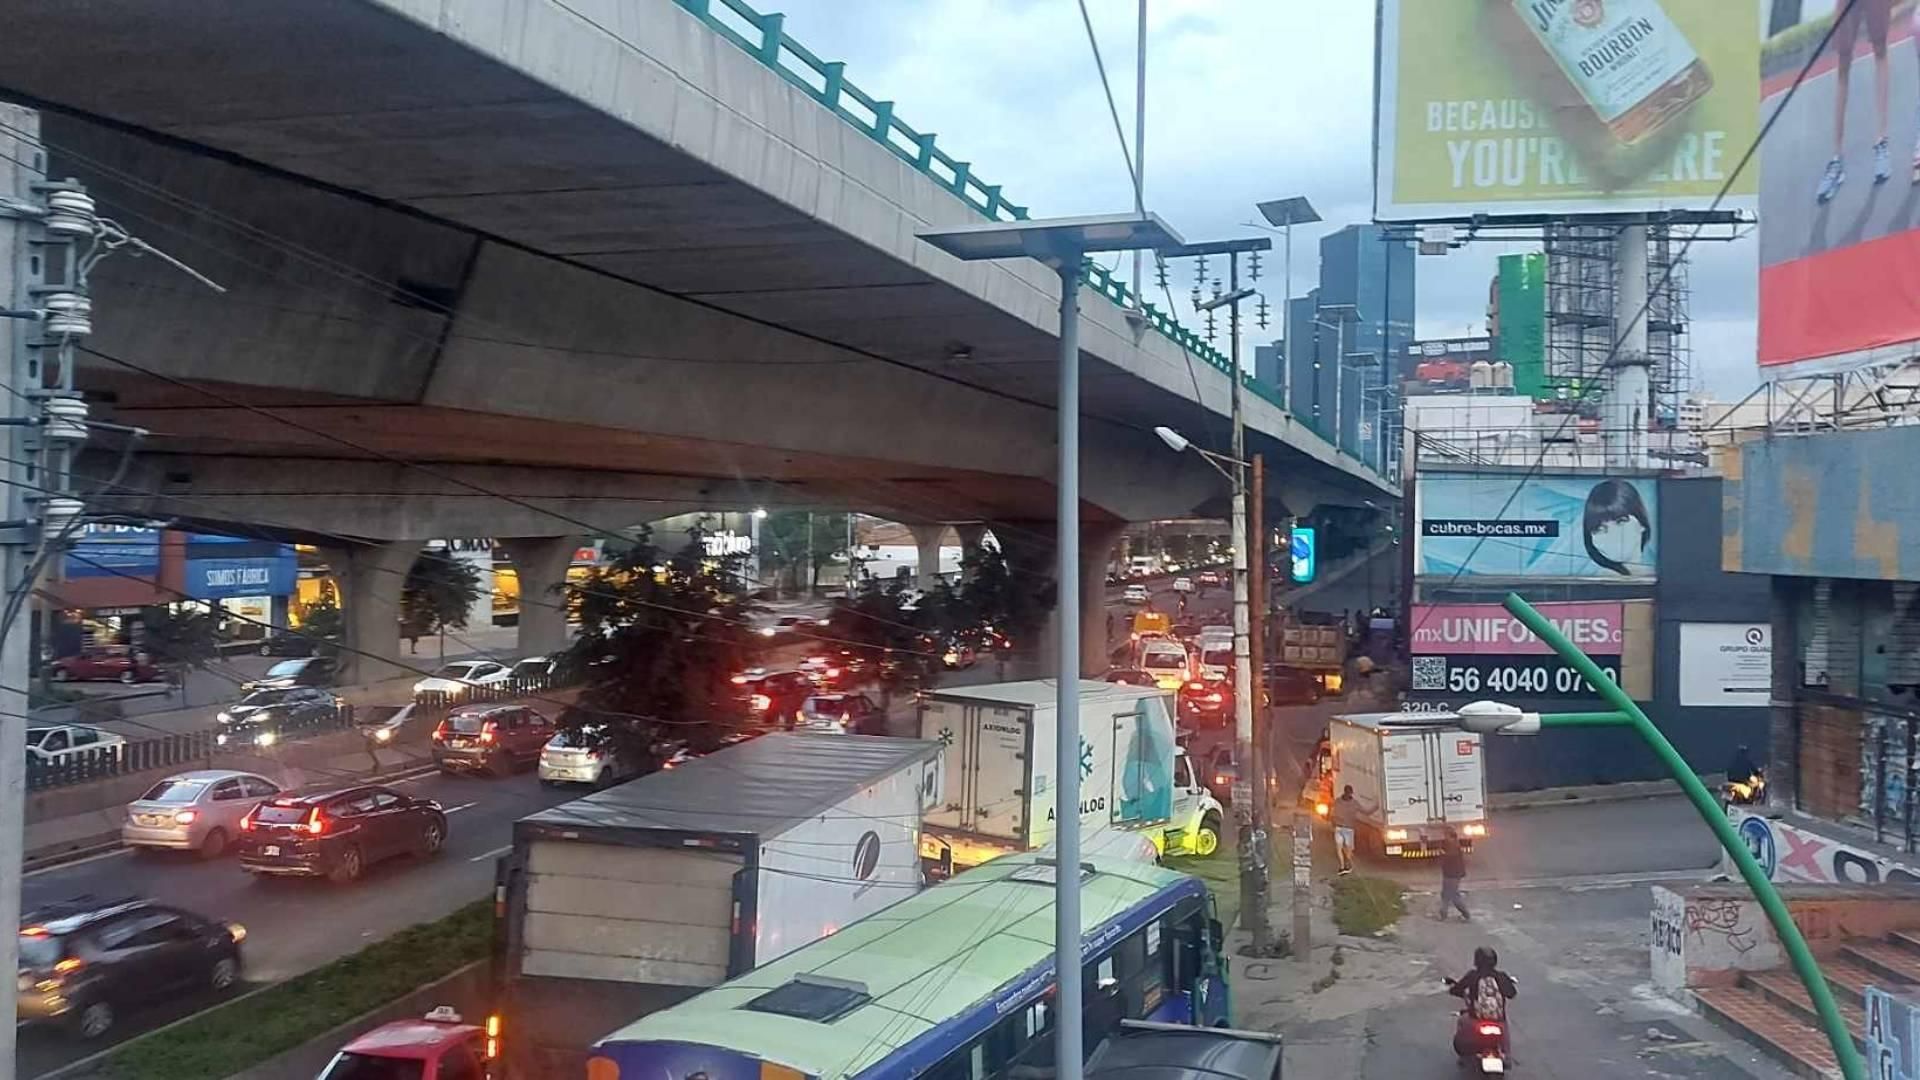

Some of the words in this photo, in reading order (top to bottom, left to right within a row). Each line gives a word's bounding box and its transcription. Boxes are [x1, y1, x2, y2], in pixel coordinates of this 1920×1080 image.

[1578, 17, 1654, 78] BOURBON
[1429, 522, 1547, 535] cubre-bocas.mx
[206, 570, 235, 587] SOMOS
[1414, 617, 1622, 643] mxUNIFOMES.c
[1450, 667, 1480, 692] 56
[1487, 667, 1548, 692] 4040
[1556, 666, 1617, 692] 07
[1047, 797, 1105, 821] ALOG
